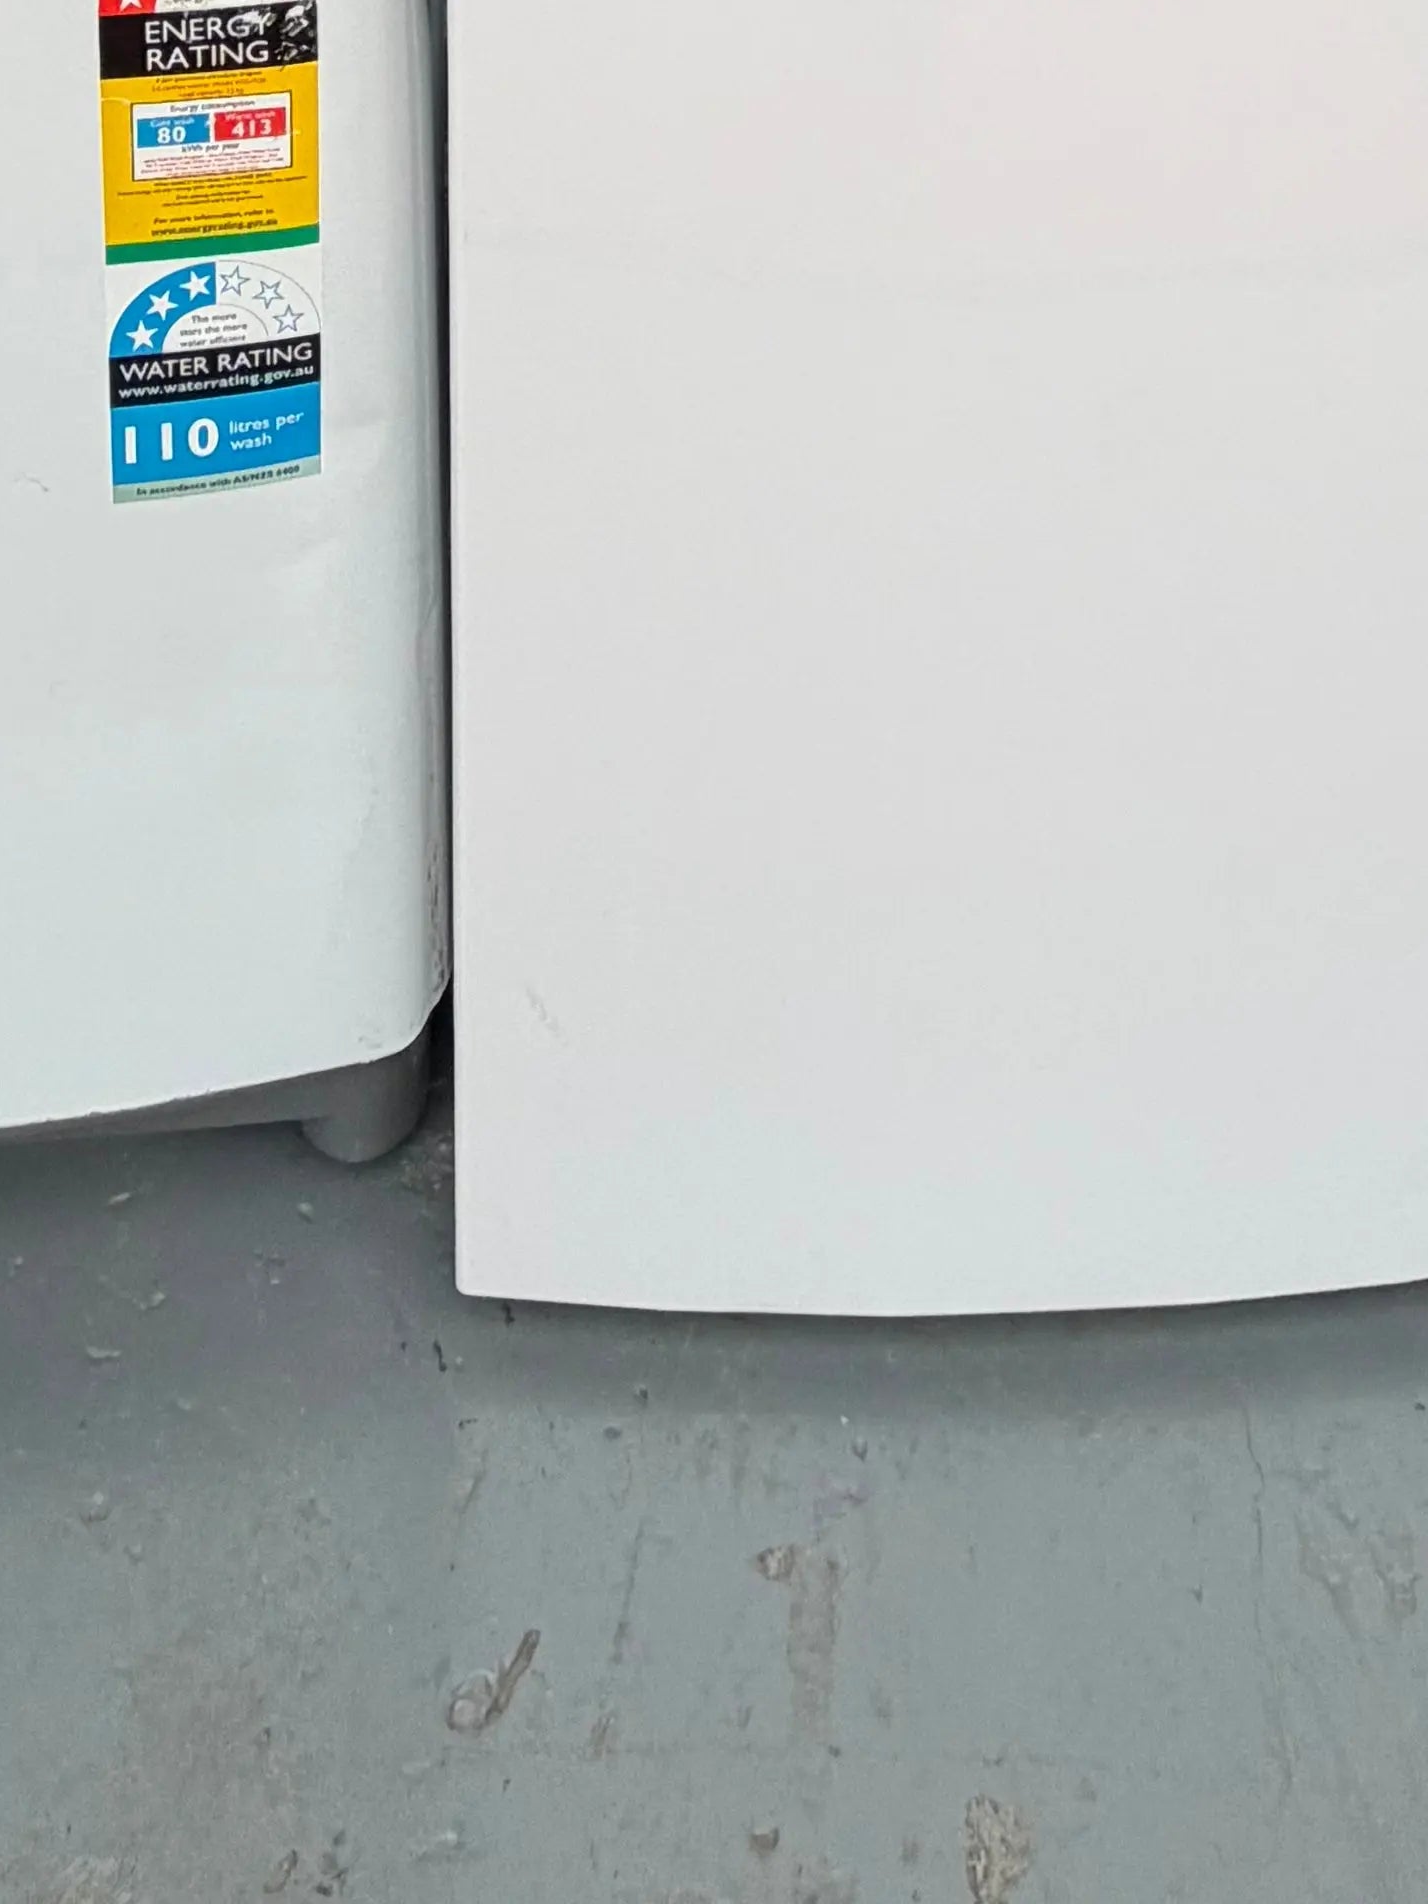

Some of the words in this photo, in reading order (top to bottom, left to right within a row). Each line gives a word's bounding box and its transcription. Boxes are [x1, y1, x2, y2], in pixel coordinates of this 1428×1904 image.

[144, 10, 269, 45] ENERGY
[145, 41, 270, 72] RATING
[156, 126, 187, 145] 80
[231, 119, 273, 138] 413
[191, 314, 210, 324] The
[212, 313, 237, 322] more
[223, 322, 248, 332] more
[180, 337, 207, 348] water
[119, 356, 209, 383] WATER
[217, 342, 313, 373] RATING
[118, 364, 314, 399] www.waterrating.gov.au
[124, 417, 220, 465] 110
[229, 418, 270, 435] litres
[275, 411, 305, 431] per
[230, 432, 273, 451] wash
